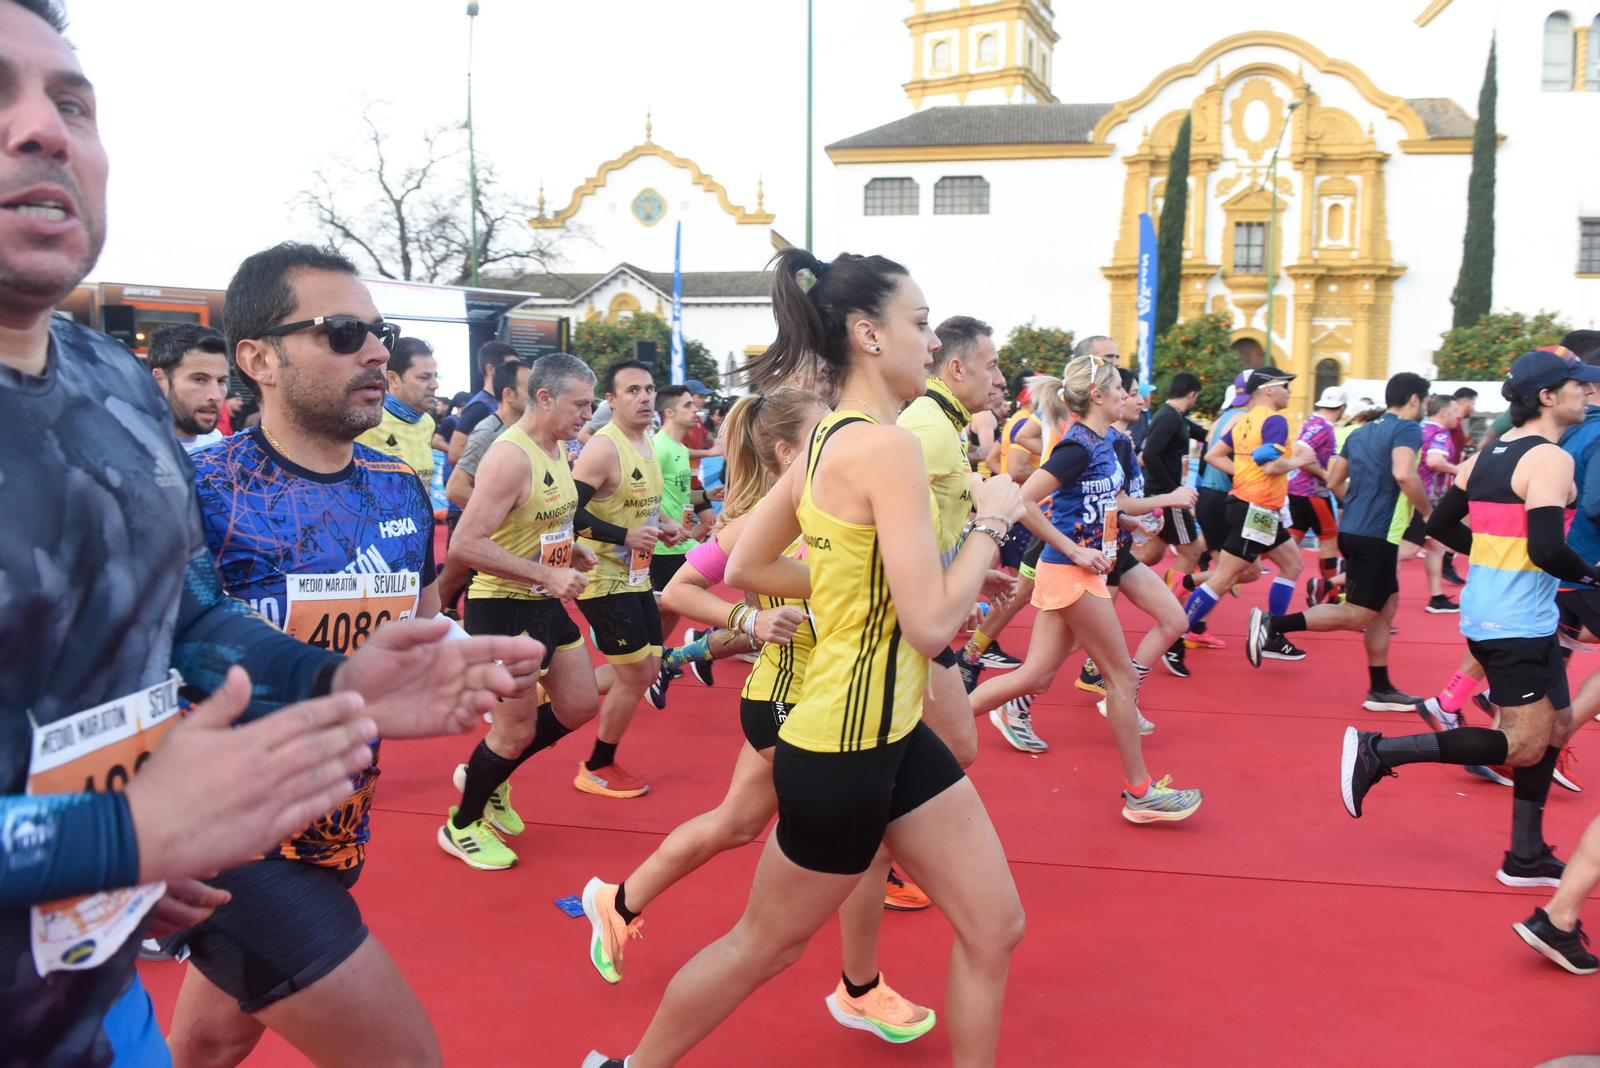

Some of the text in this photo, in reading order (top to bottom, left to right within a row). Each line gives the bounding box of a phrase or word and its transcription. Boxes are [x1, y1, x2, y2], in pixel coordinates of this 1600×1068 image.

[1082, 478, 1112, 494] MEDIO
[379, 517, 418, 539] HOKA
[336, 544, 391, 575] TÓN
[299, 575, 407, 594] MEDIO MARATÓN SEVILLA
